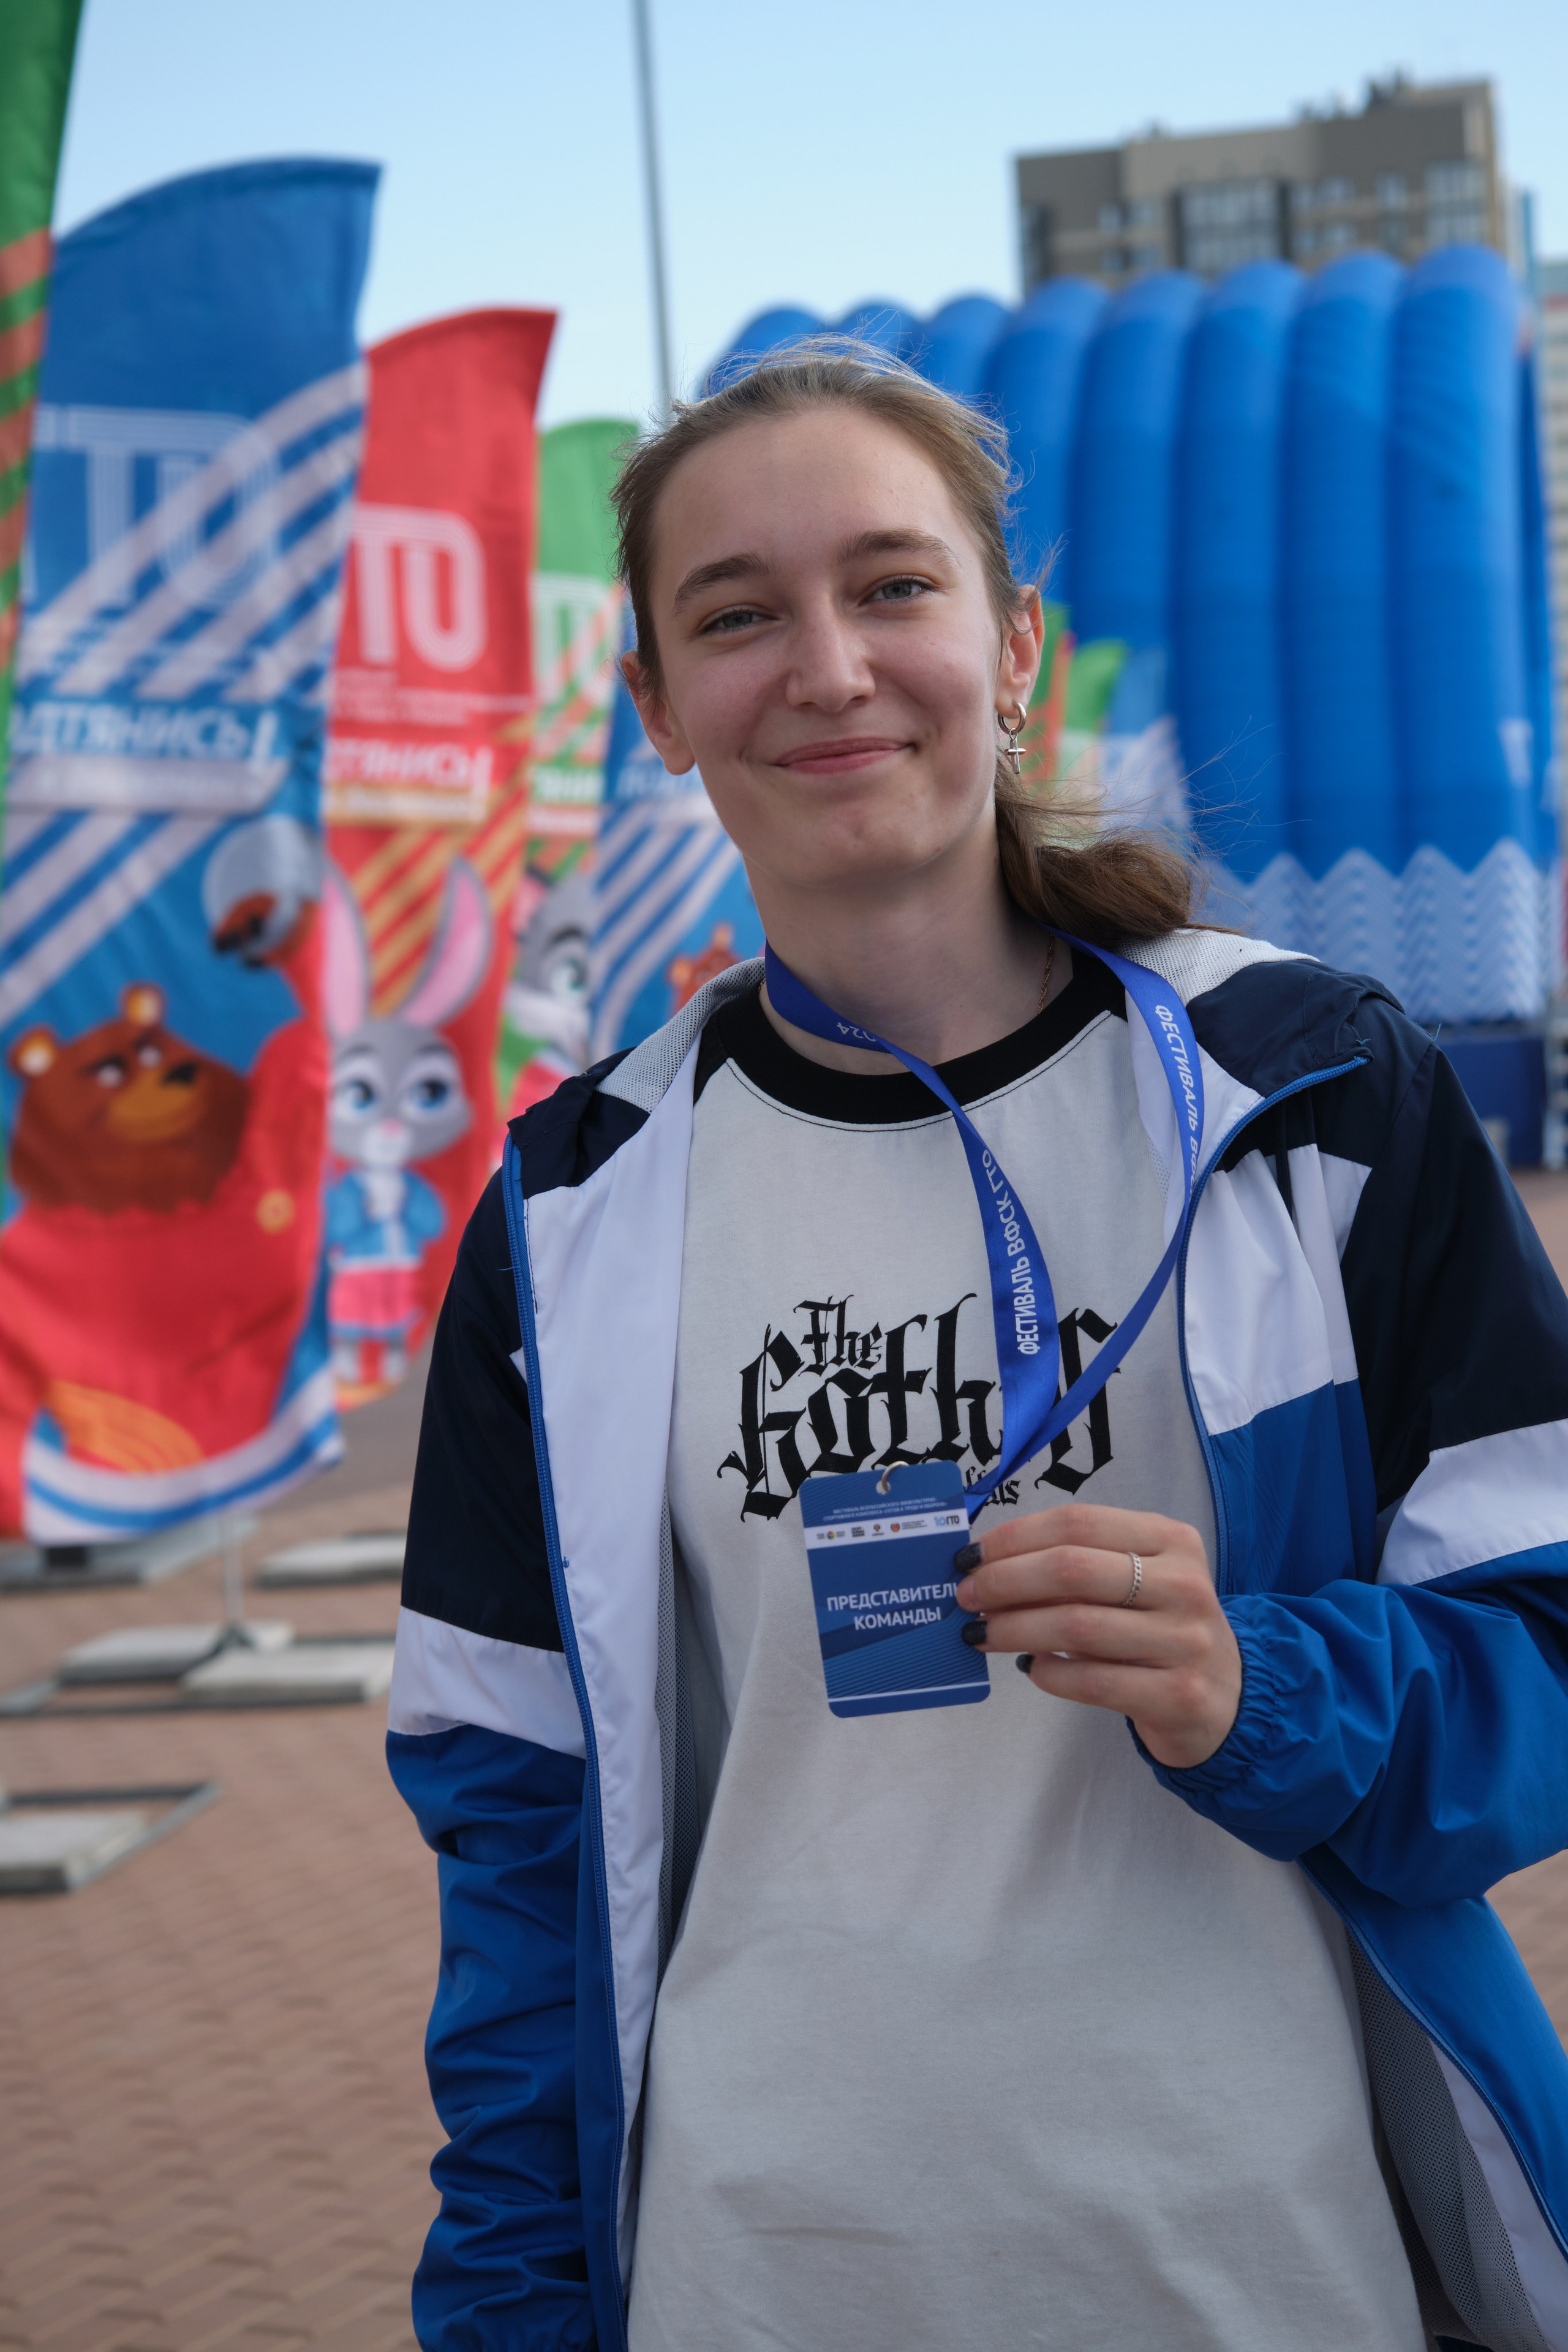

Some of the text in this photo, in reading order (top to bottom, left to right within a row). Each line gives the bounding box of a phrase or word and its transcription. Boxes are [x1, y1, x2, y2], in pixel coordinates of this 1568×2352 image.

[1155, 1005, 1198, 1132] ФЕСТИВАЛЬ
[982, 1150, 1041, 1355] ФЕСТИВАЛЬ ВФСК ГТО
[793, 1294, 882, 1377] The
[946, 1515, 960, 1525] ГТО
[854, 1607, 941, 1630] КОМАНДЫ
